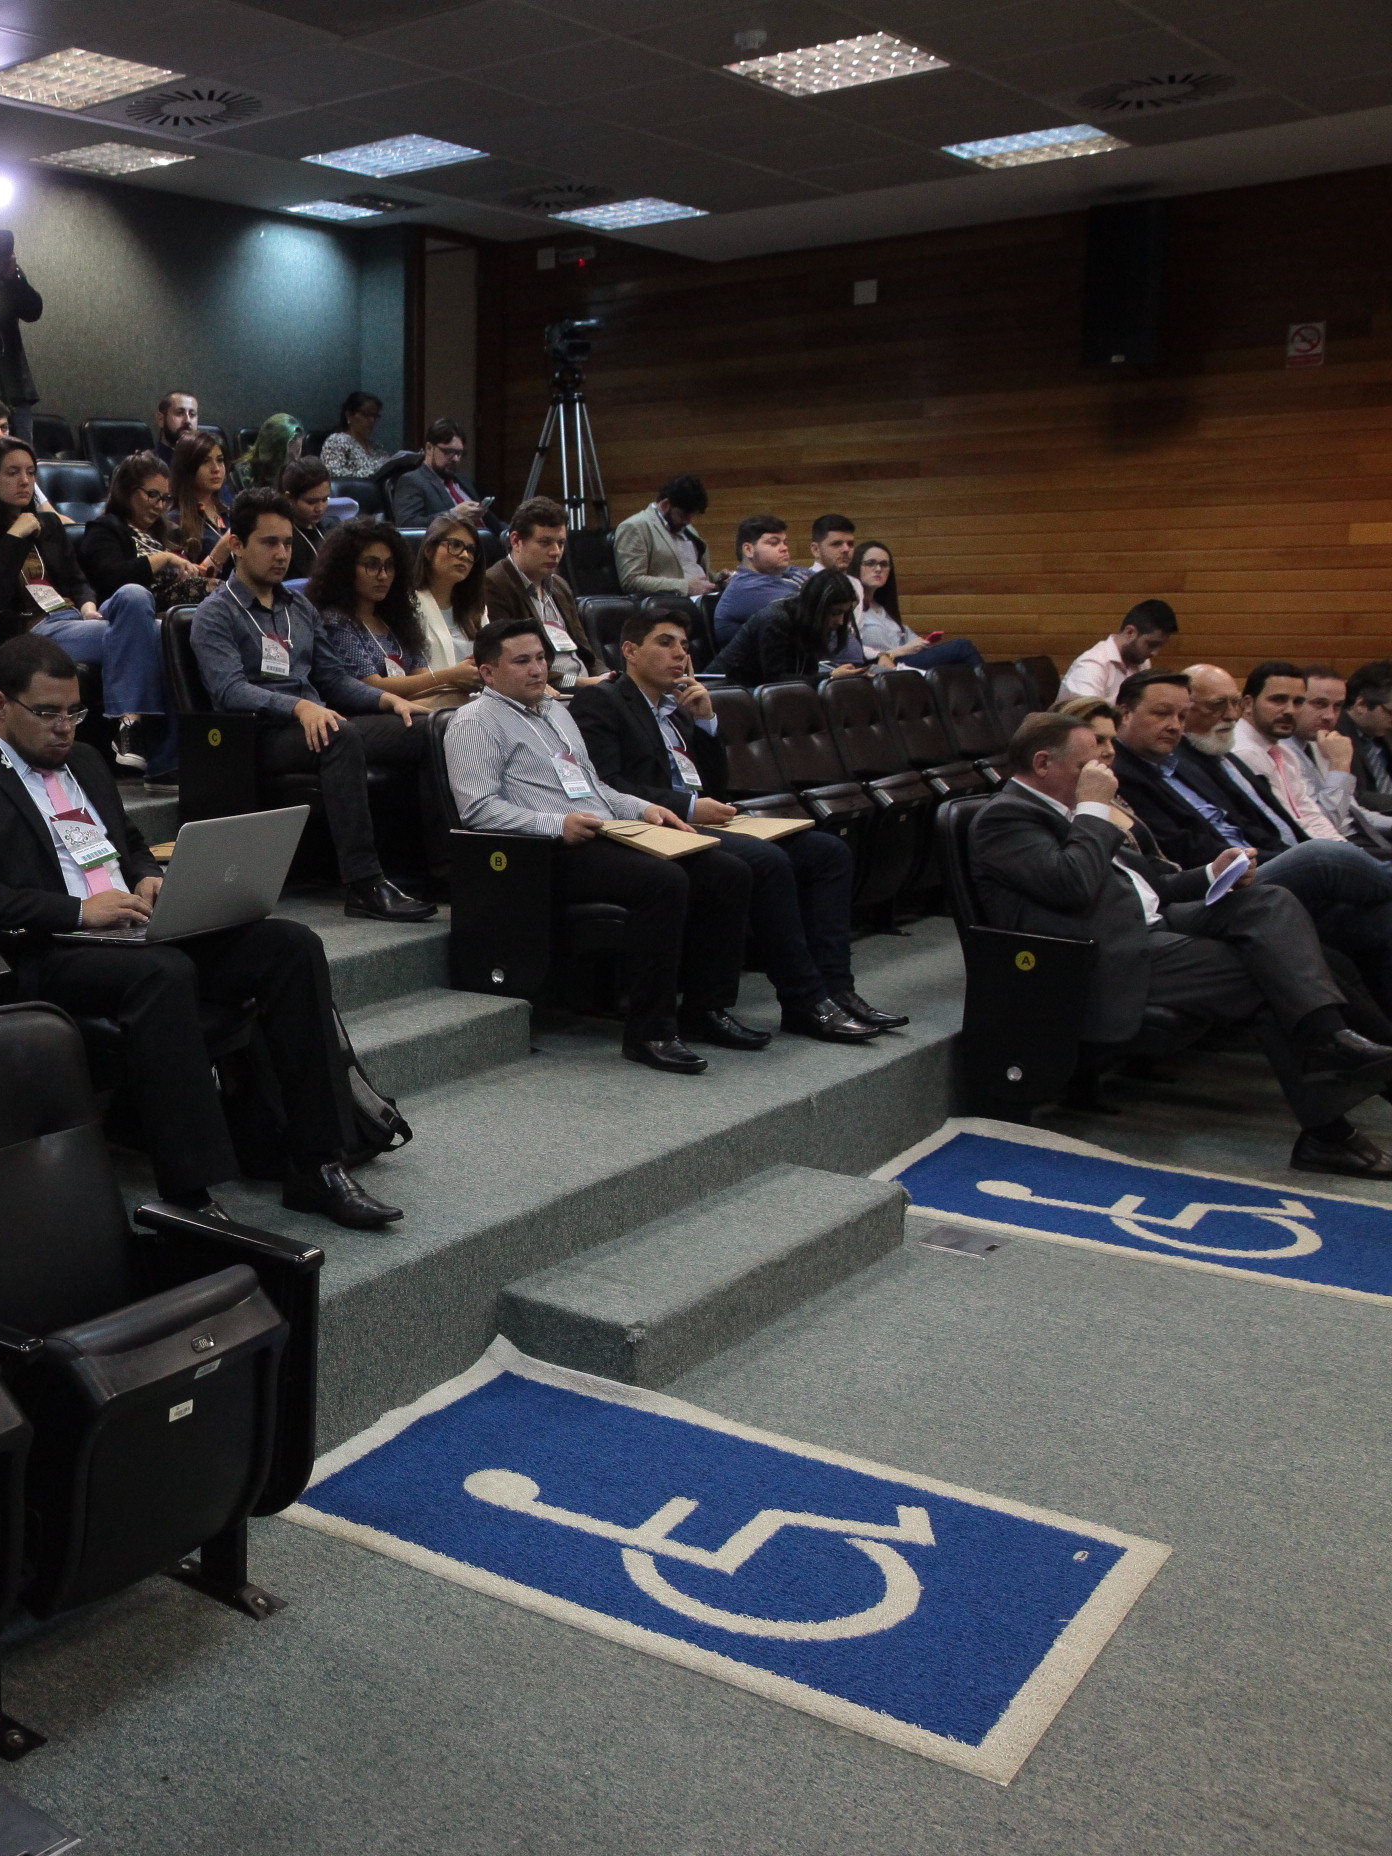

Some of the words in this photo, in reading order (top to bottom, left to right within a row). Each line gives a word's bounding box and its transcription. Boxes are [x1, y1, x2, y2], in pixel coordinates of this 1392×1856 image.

[212, 732, 218, 742] C
[495, 856, 503, 867] B
[1021, 956, 1031, 966] A
